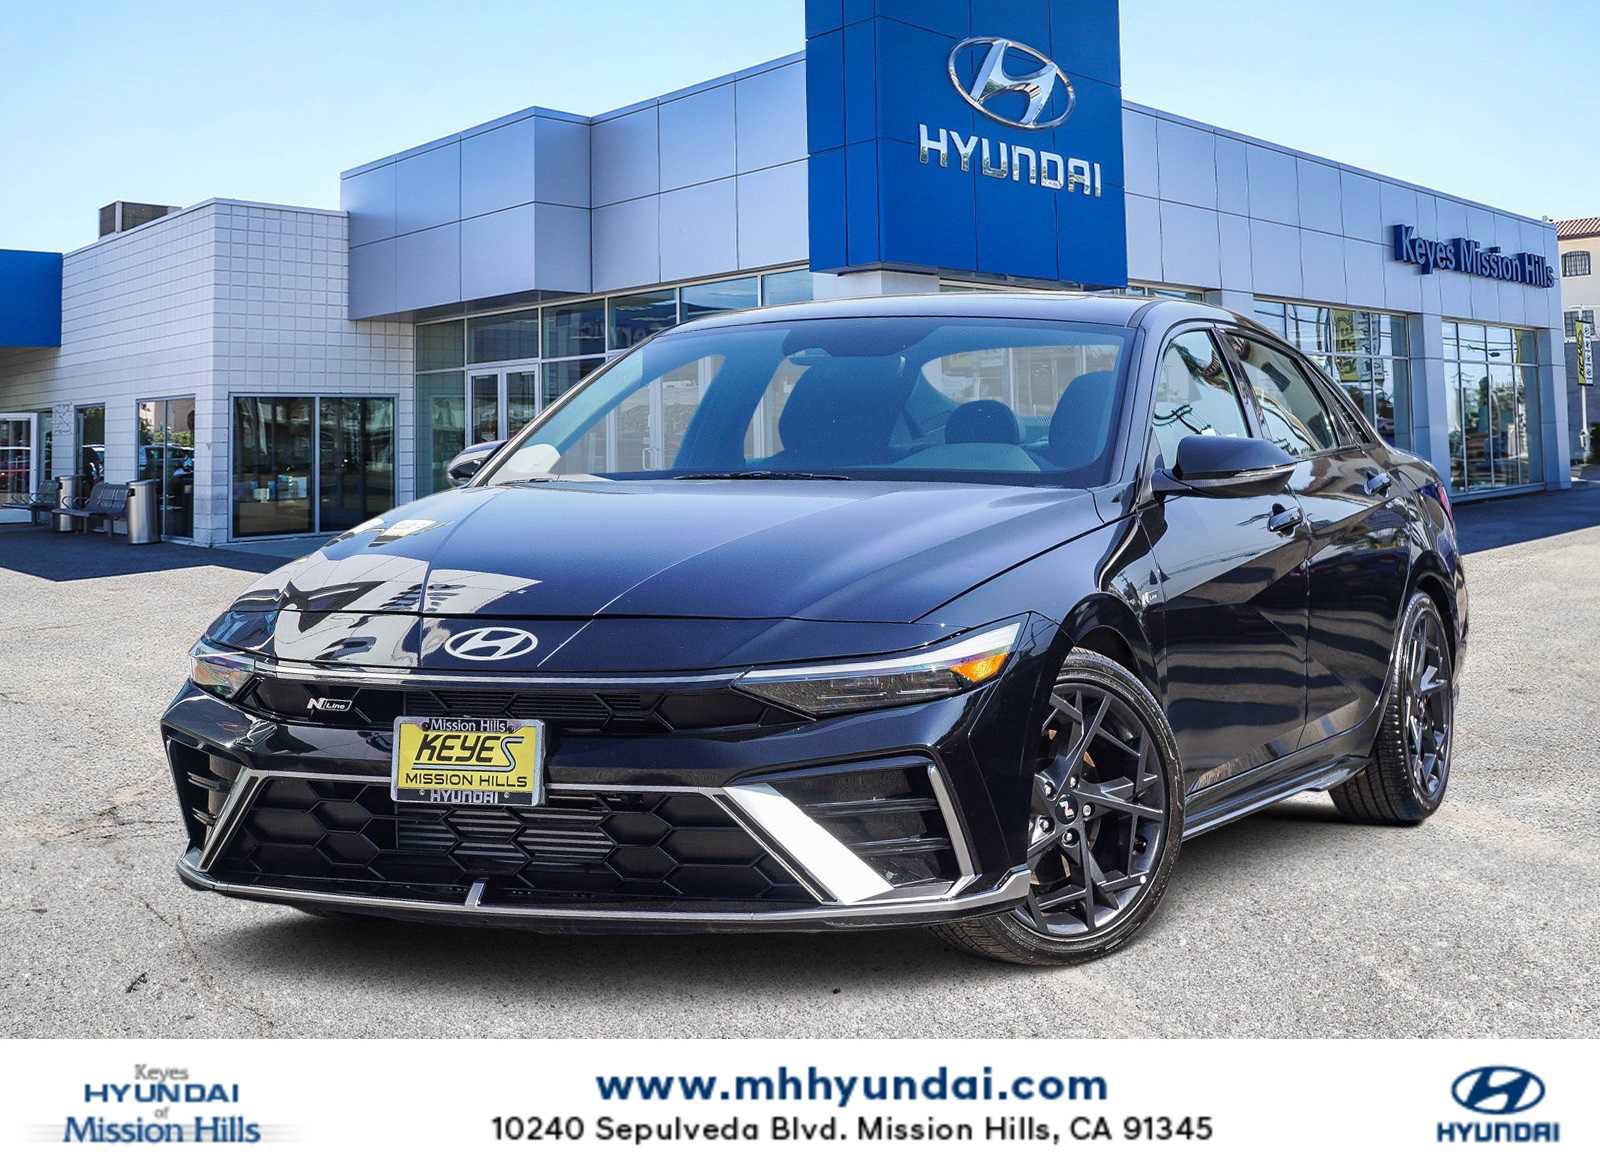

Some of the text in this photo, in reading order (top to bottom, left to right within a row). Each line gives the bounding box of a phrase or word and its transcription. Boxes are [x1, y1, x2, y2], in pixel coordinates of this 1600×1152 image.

[919, 123, 1102, 198] HYUNDAI
[1394, 224, 1555, 289] Keyes Mission Hills
[326, 702, 346, 710] Line
[430, 719, 506, 733] Mission Hills
[414, 733, 525, 773] KEYES
[405, 772, 528, 788] MISSION HILLS
[430, 789, 499, 804] HYUNDAI
